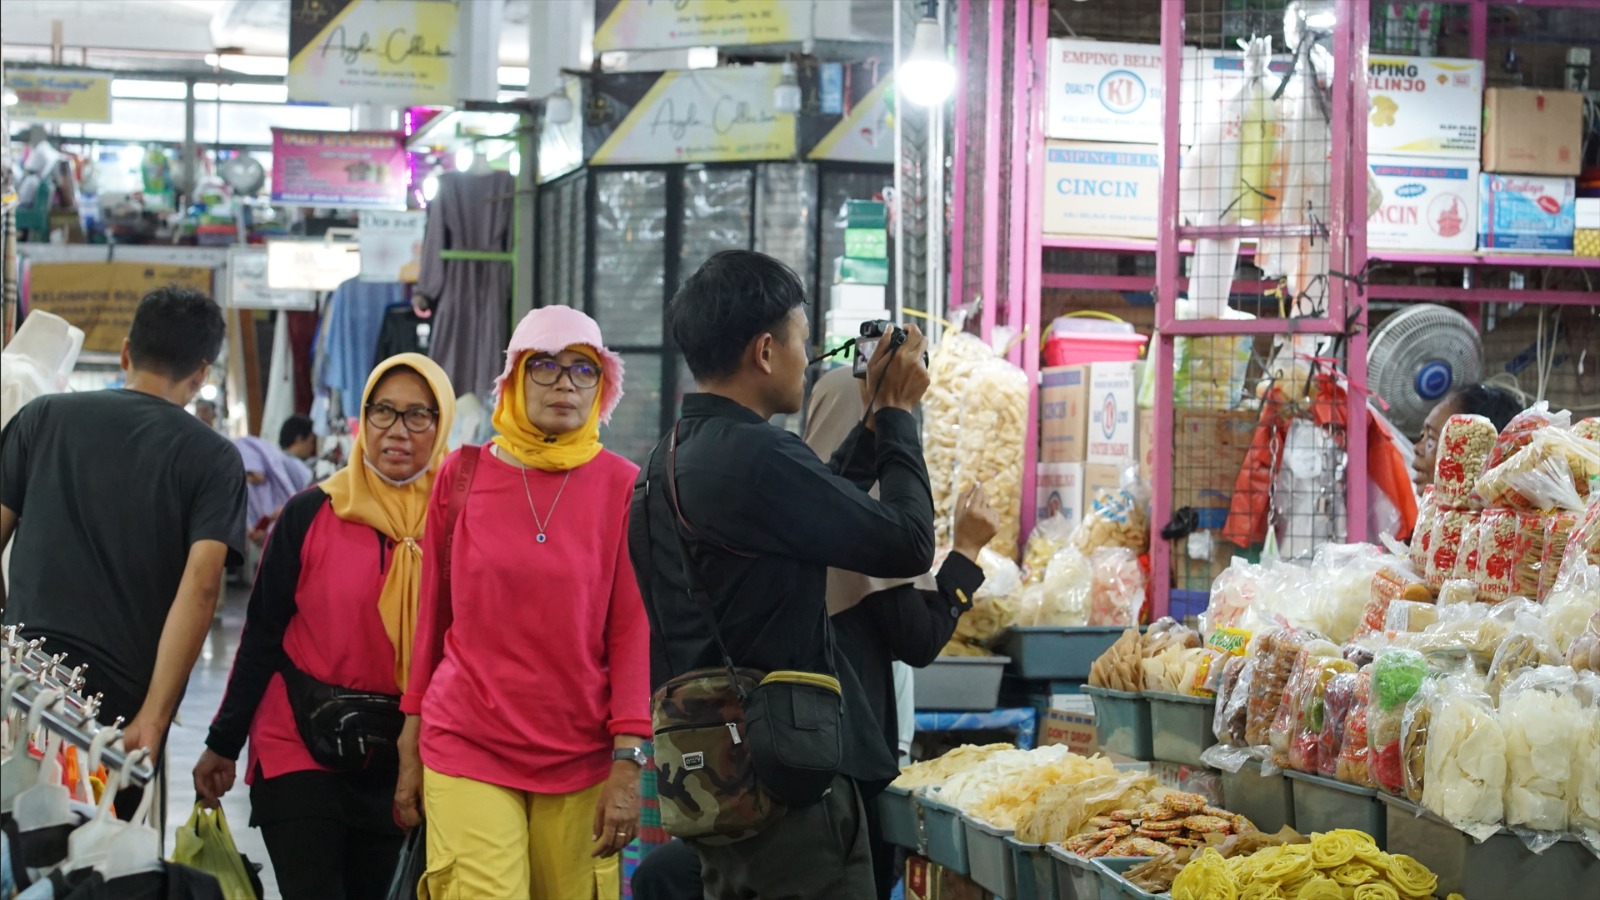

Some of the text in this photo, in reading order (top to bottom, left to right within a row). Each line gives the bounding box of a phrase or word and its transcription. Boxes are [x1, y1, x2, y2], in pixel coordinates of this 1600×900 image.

[1062, 50, 1119, 66] EMPING
[1064, 82, 1095, 95] QUALITY
[1051, 149, 1112, 164] EMPING
[1056, 178, 1138, 198] CINCIN
[1071, 731, 1092, 744] DROP
